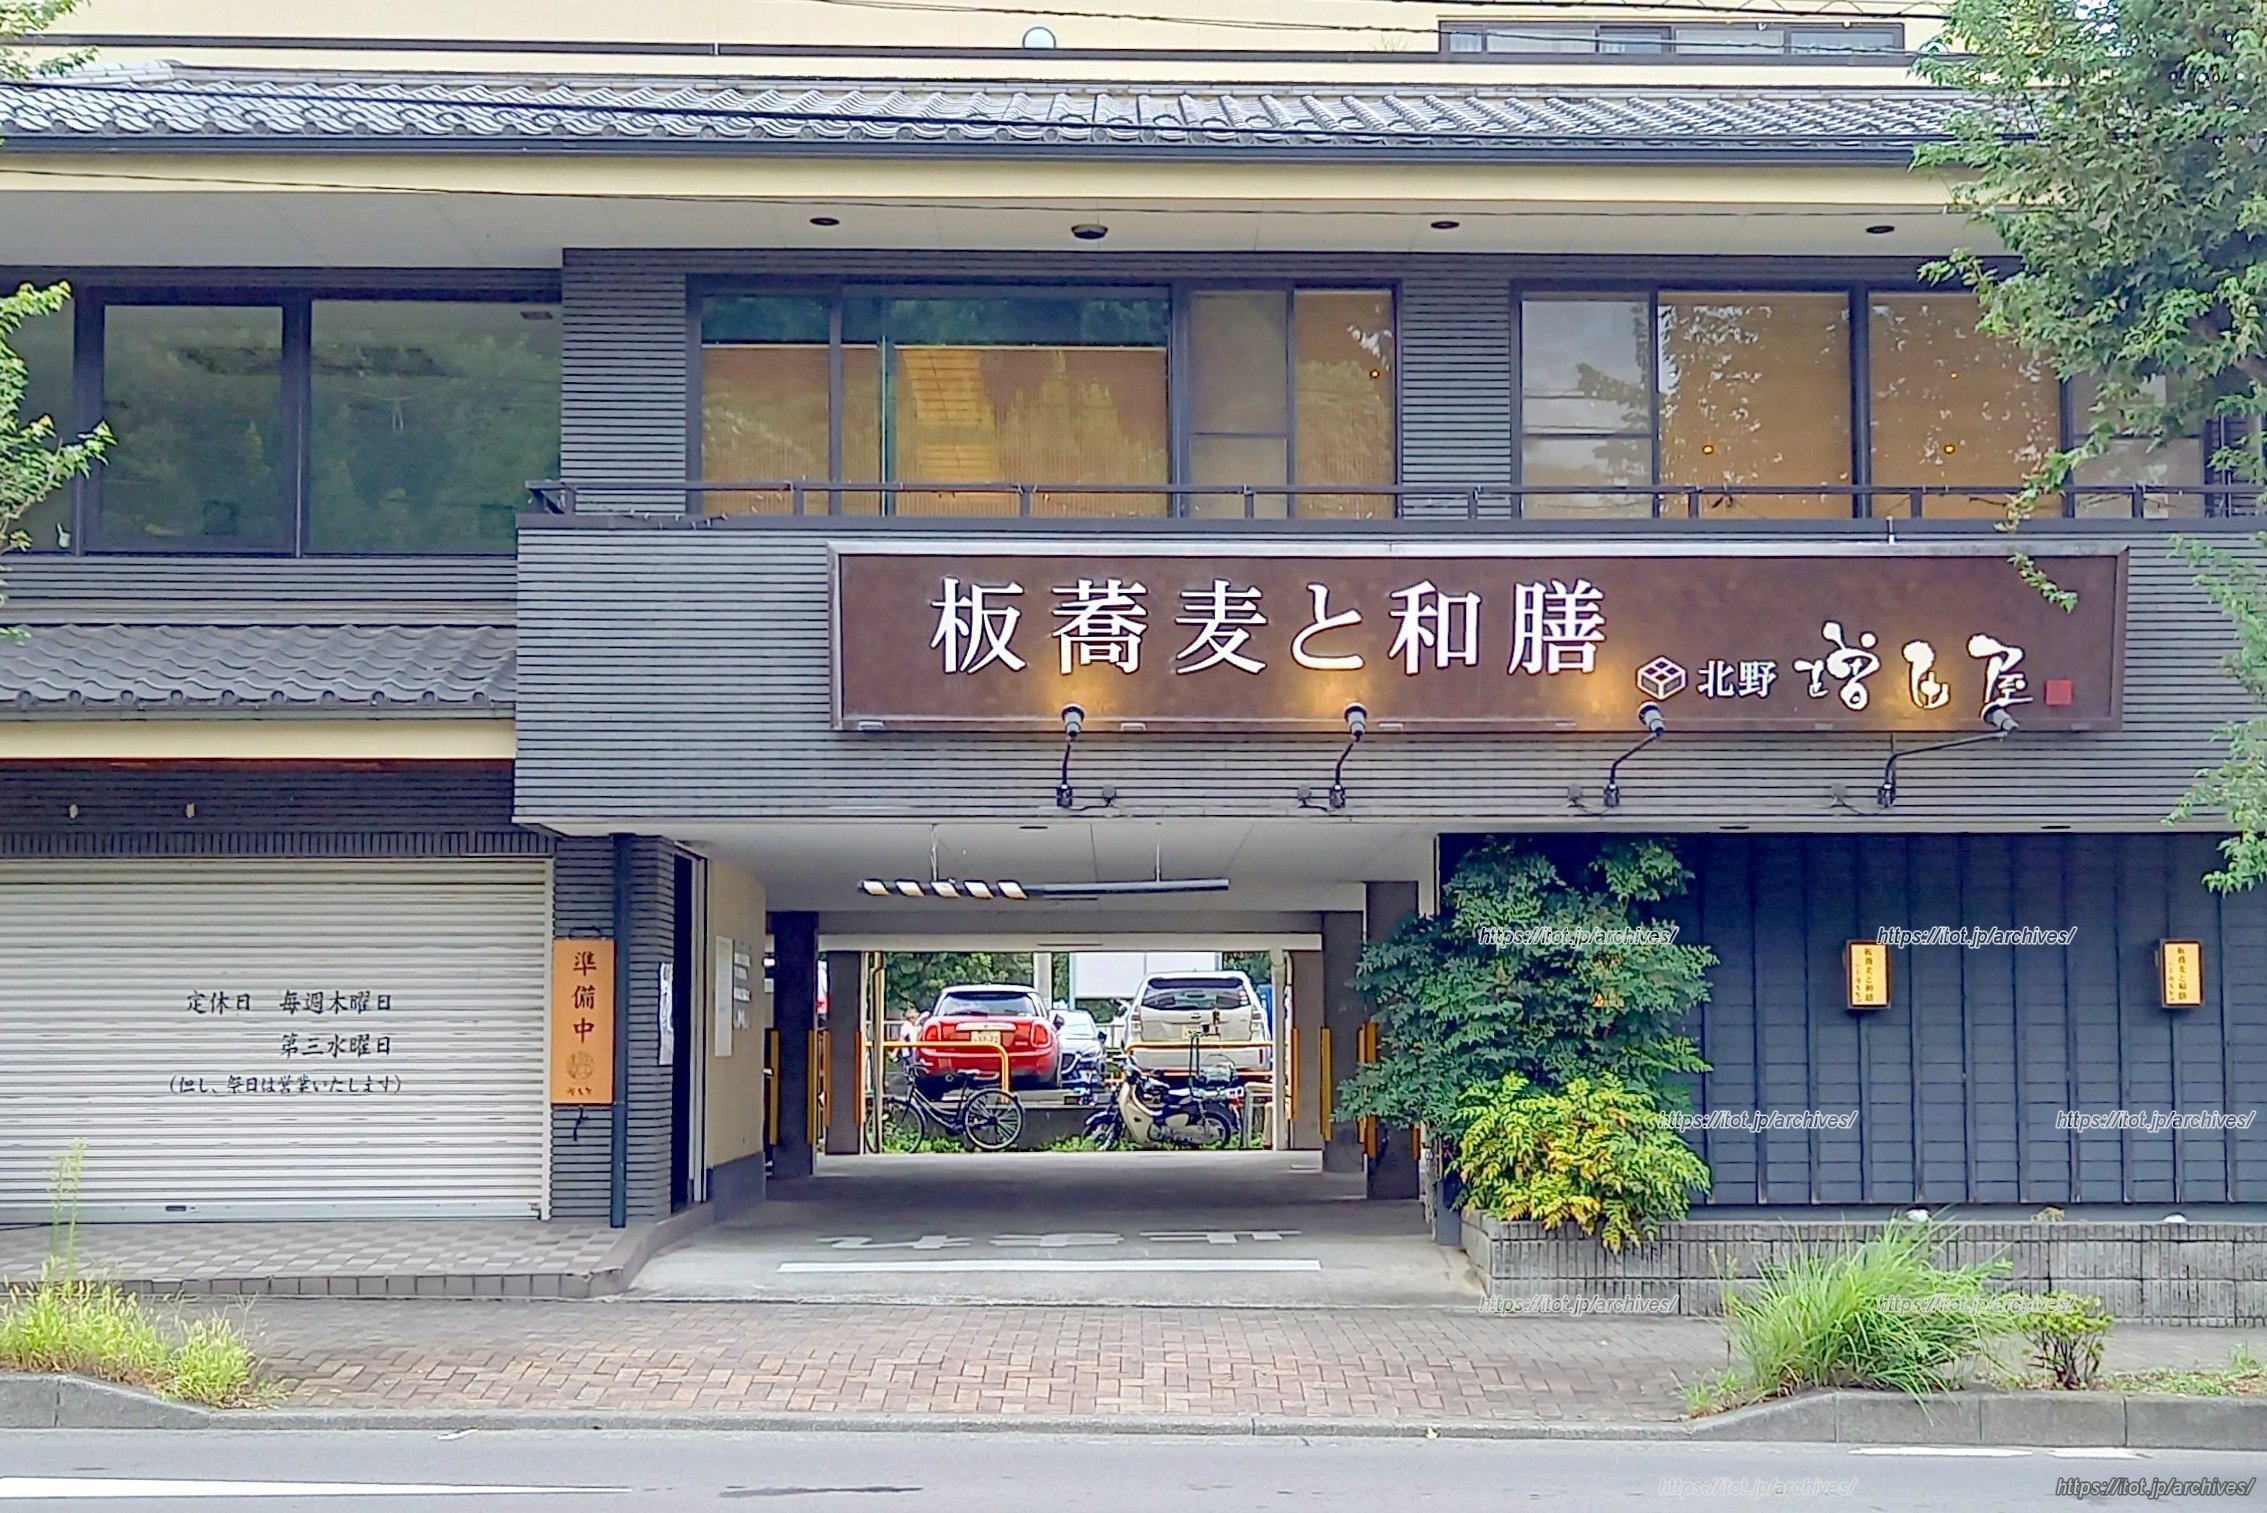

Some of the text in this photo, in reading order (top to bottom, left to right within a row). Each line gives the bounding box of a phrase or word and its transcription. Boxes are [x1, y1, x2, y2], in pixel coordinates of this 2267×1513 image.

[929, 578, 1606, 675] 板蕎麦と和膳
[1698, 660, 1779, 699] 北野
[186, 990, 392, 1015] 定休日 毎週木曜日
[571, 951, 597, 1044] 準備中
[280, 1033, 391, 1058] 第三水曜日
